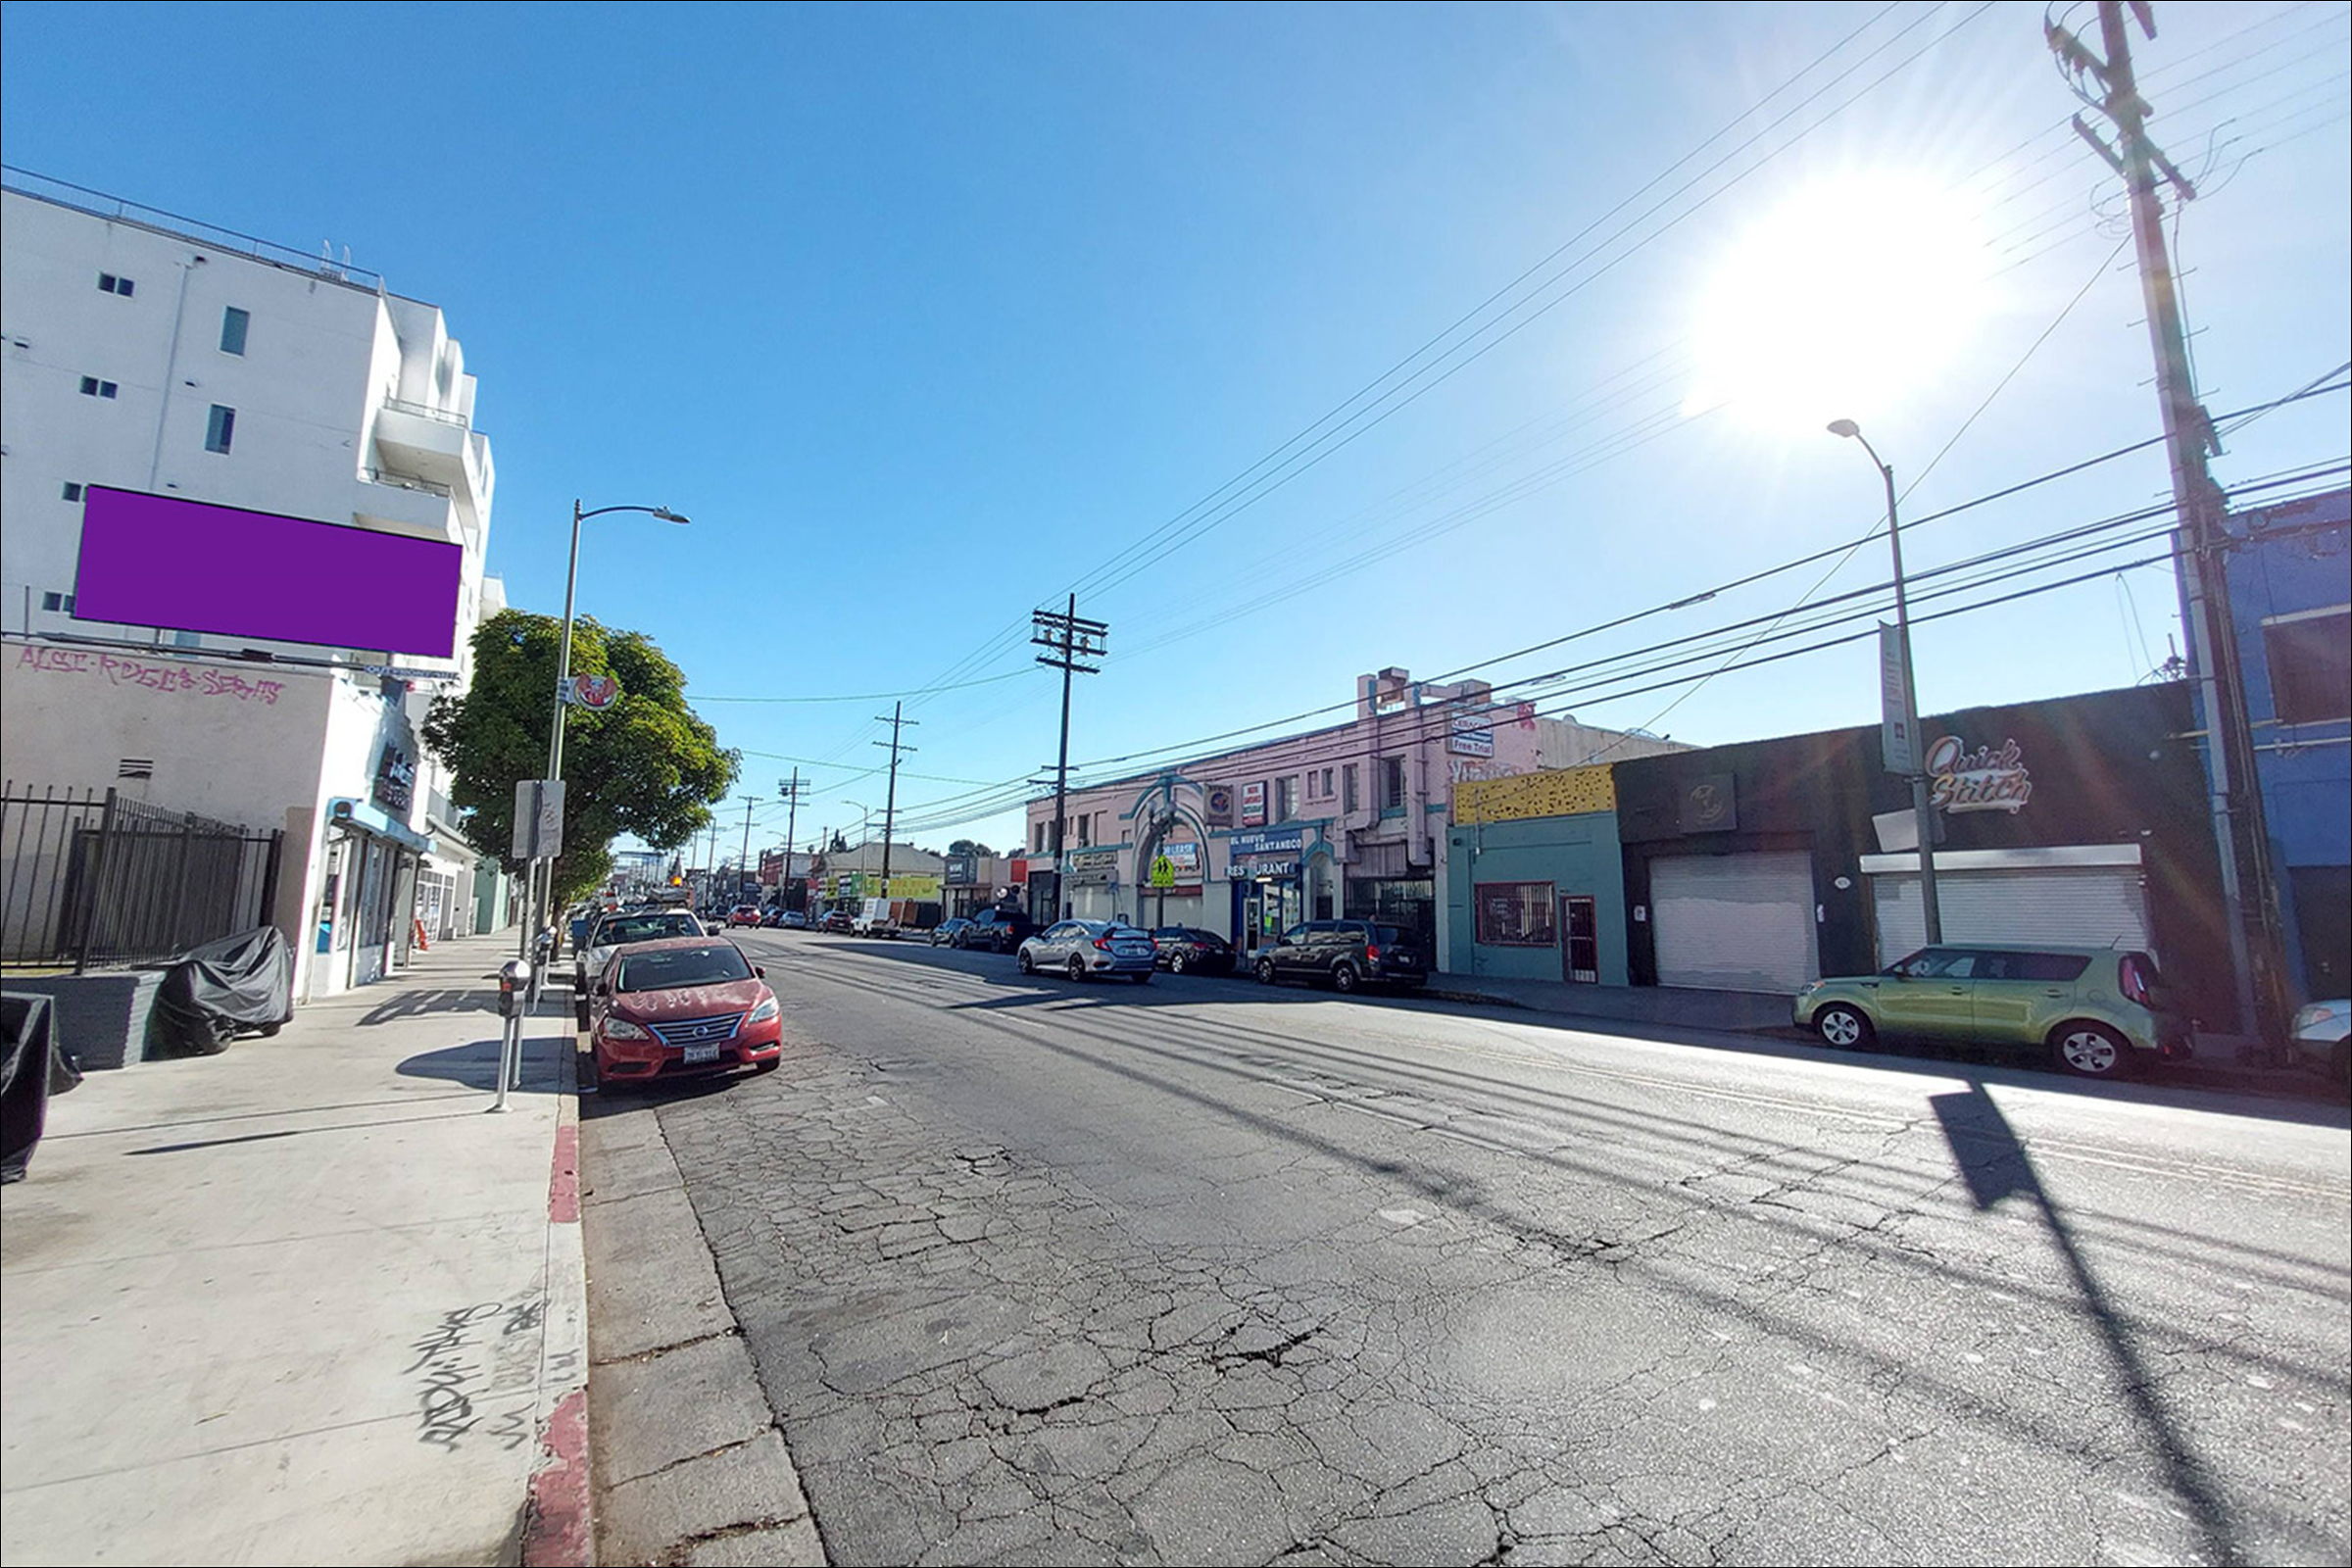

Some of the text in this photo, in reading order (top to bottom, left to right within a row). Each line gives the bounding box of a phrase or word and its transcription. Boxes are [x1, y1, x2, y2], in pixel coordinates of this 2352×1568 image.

[1454, 740, 1492, 754] Free Trial
[1925, 735, 2022, 778] Quick
[1930, 769, 2033, 812] Stitch
[1171, 843, 1194, 855] LEASE
[1227, 862, 1290, 876] RESURANT
